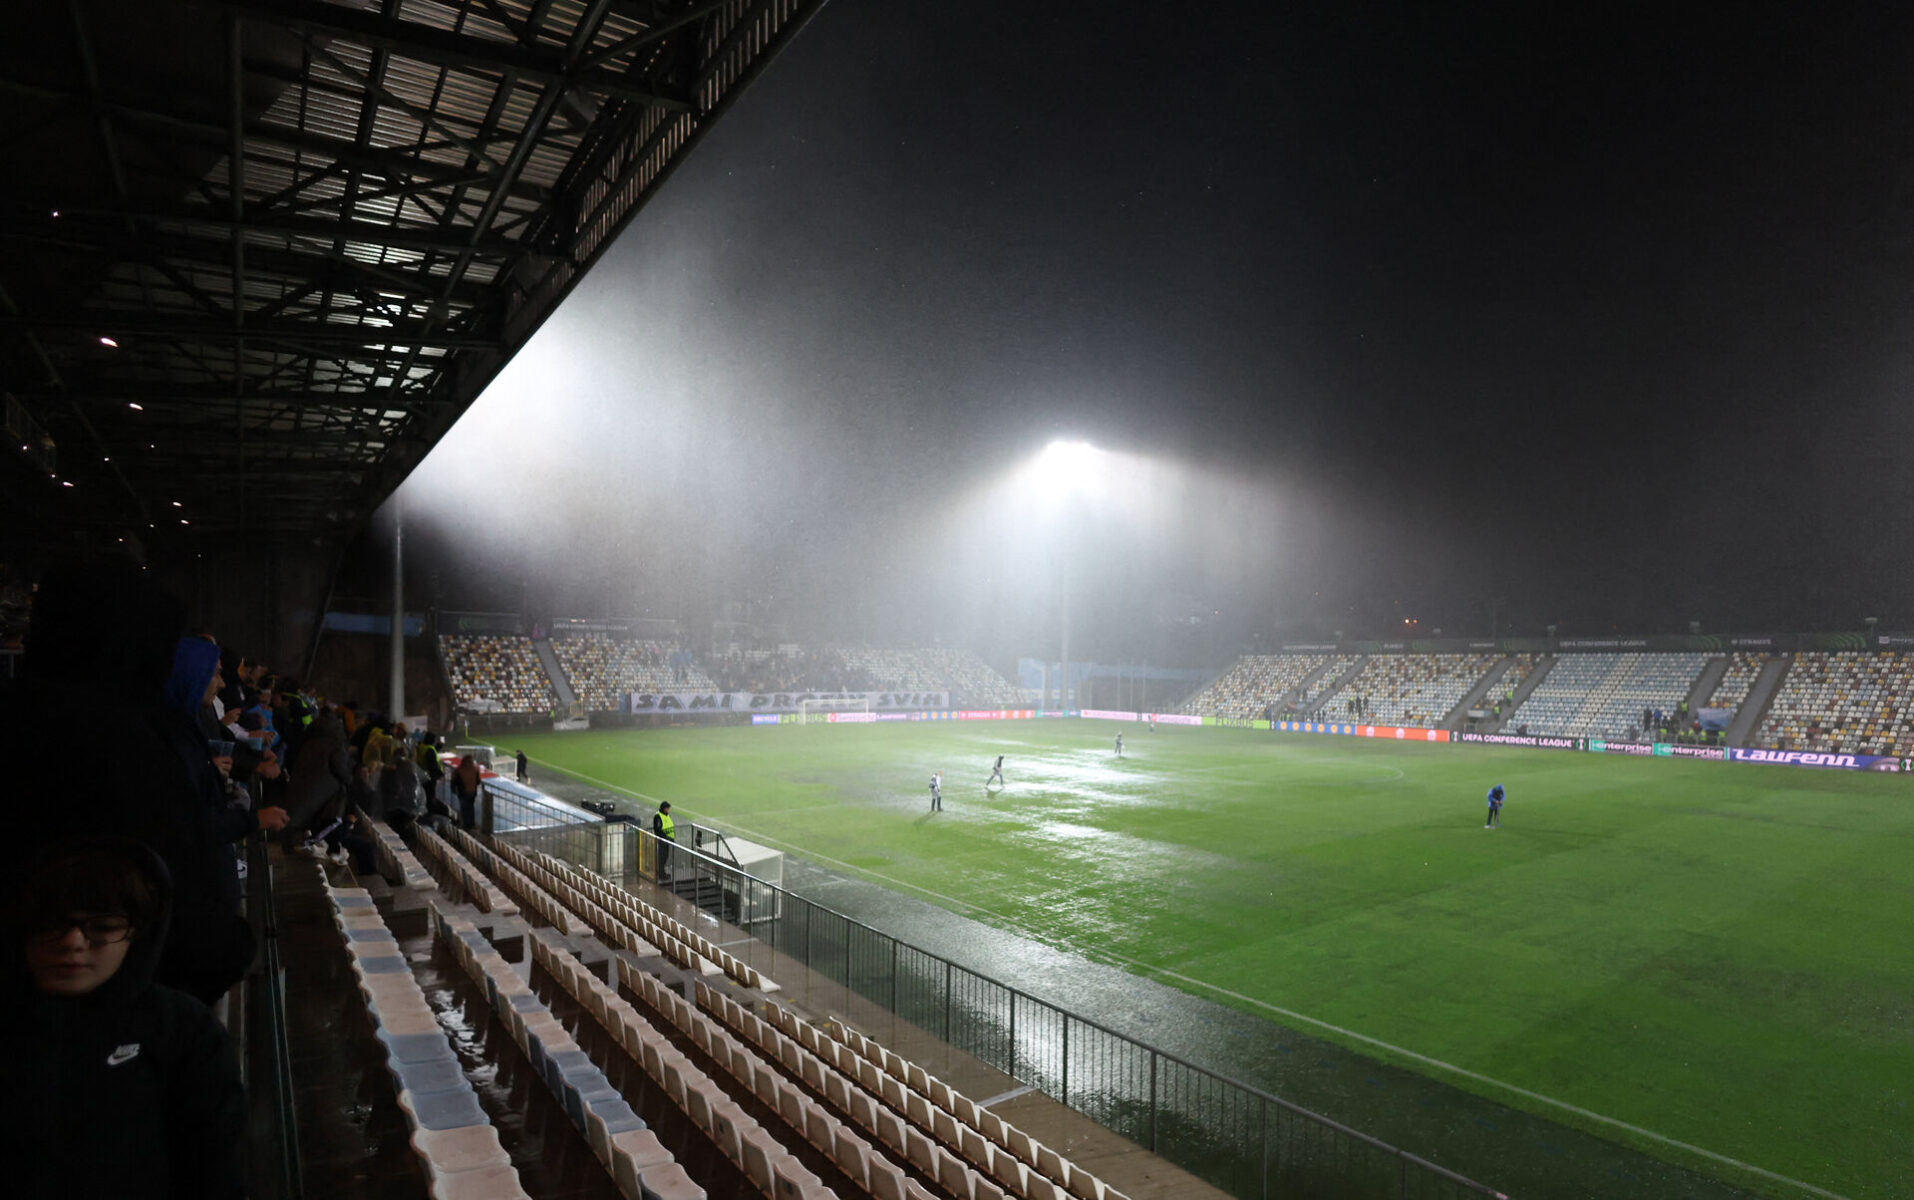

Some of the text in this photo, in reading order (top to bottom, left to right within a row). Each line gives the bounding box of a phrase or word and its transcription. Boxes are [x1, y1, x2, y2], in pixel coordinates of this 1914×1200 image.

[636, 694, 732, 709] SAMI
[1462, 733, 1573, 748] UEFA CONFERENCE LEAGUE
[1594, 740, 1652, 752] enterprise
[1660, 745, 1723, 757] enterprise
